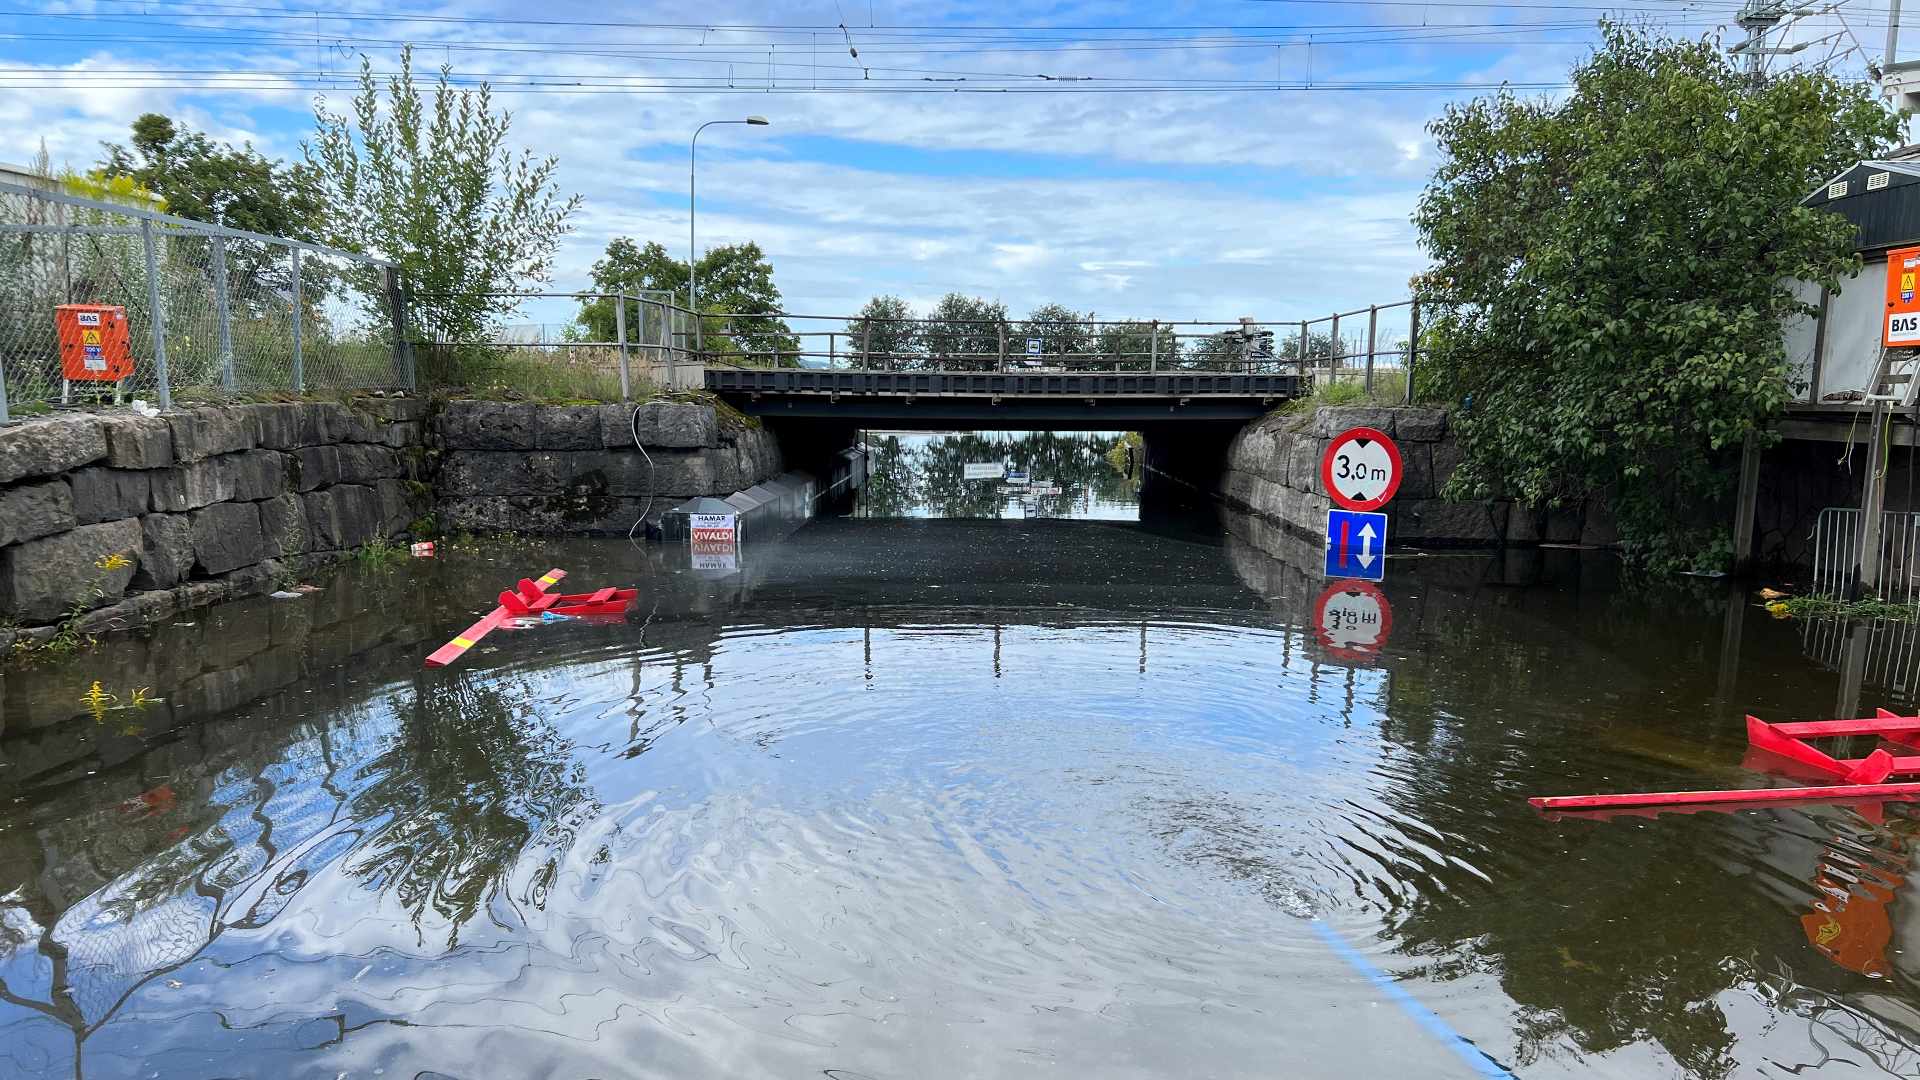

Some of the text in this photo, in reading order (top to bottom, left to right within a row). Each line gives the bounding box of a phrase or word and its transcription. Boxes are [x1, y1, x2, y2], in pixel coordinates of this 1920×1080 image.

[1892, 317, 1918, 332] BAS
[1337, 454, 1386, 481] 3,0 m
[693, 531, 733, 540] VIVALDI
